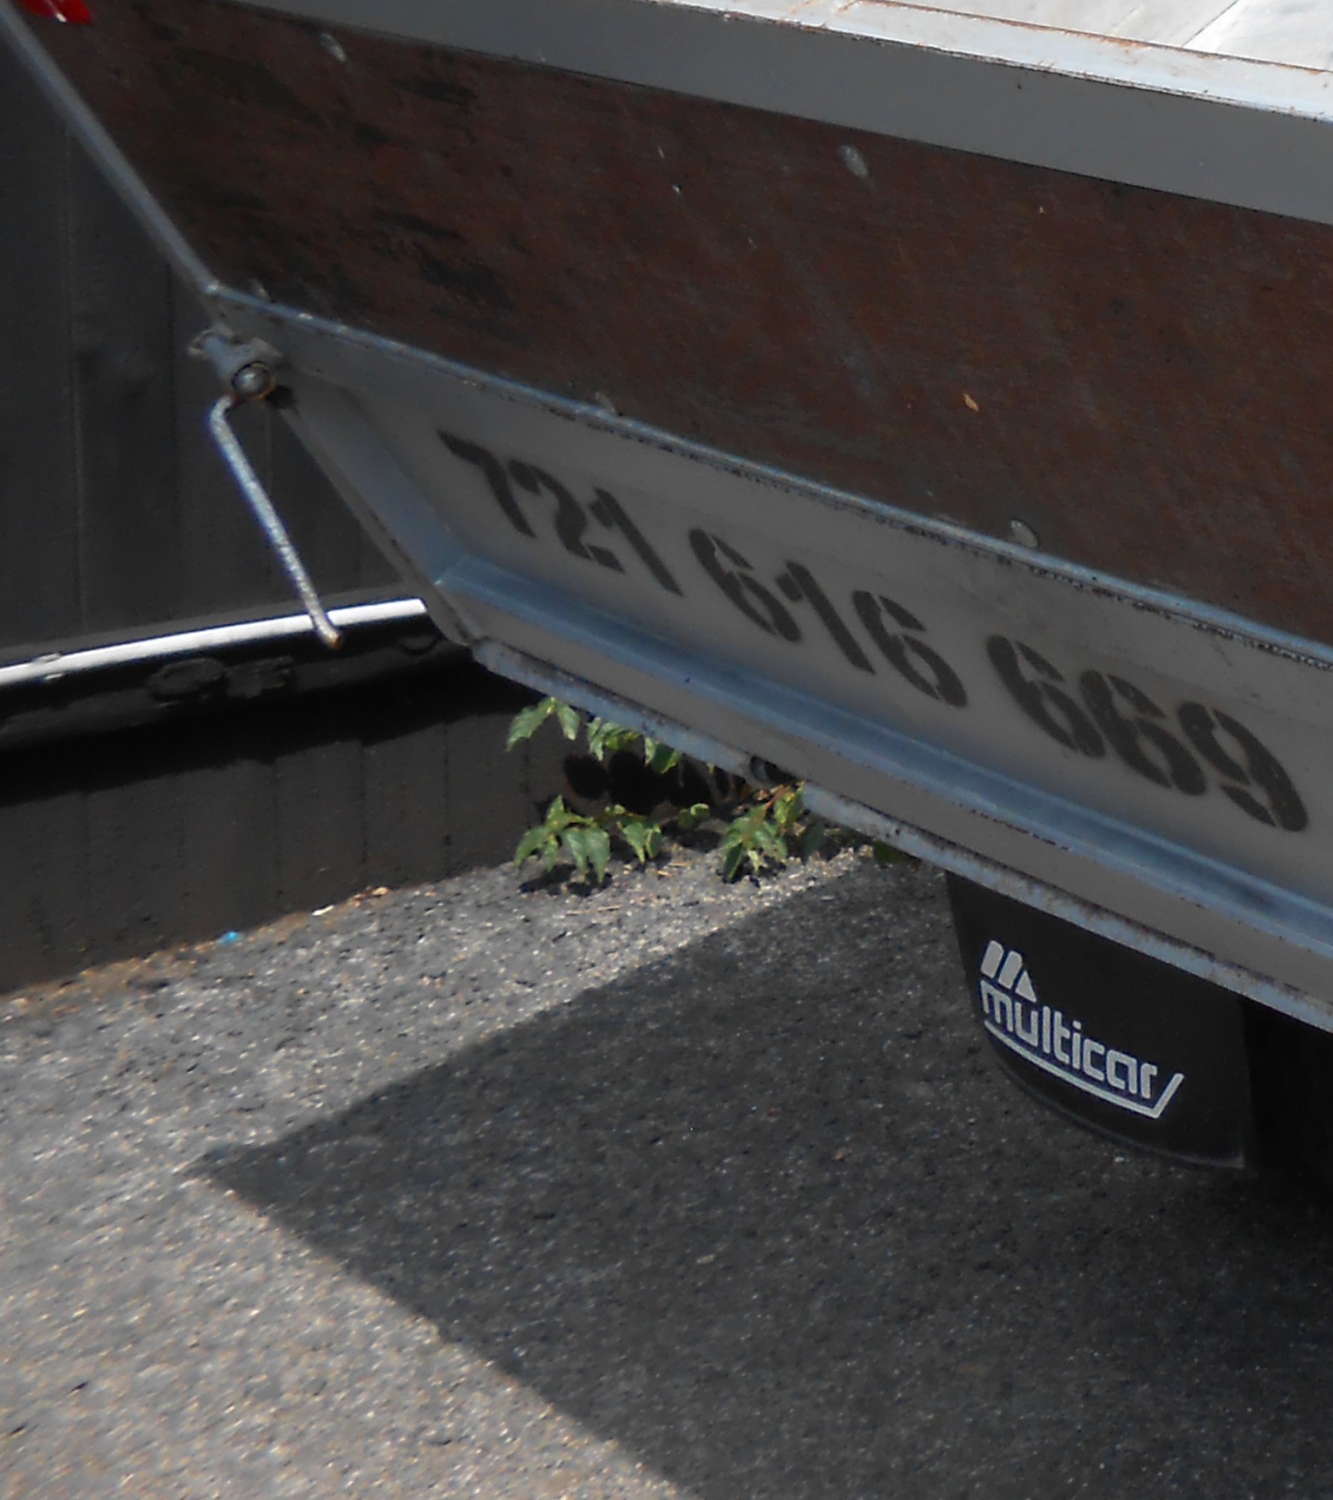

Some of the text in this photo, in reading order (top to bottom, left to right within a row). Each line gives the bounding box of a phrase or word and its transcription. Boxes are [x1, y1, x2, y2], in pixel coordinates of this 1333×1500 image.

[436, 429, 1309, 833] 721 616 669
[980, 979, 1158, 1099] multicar
